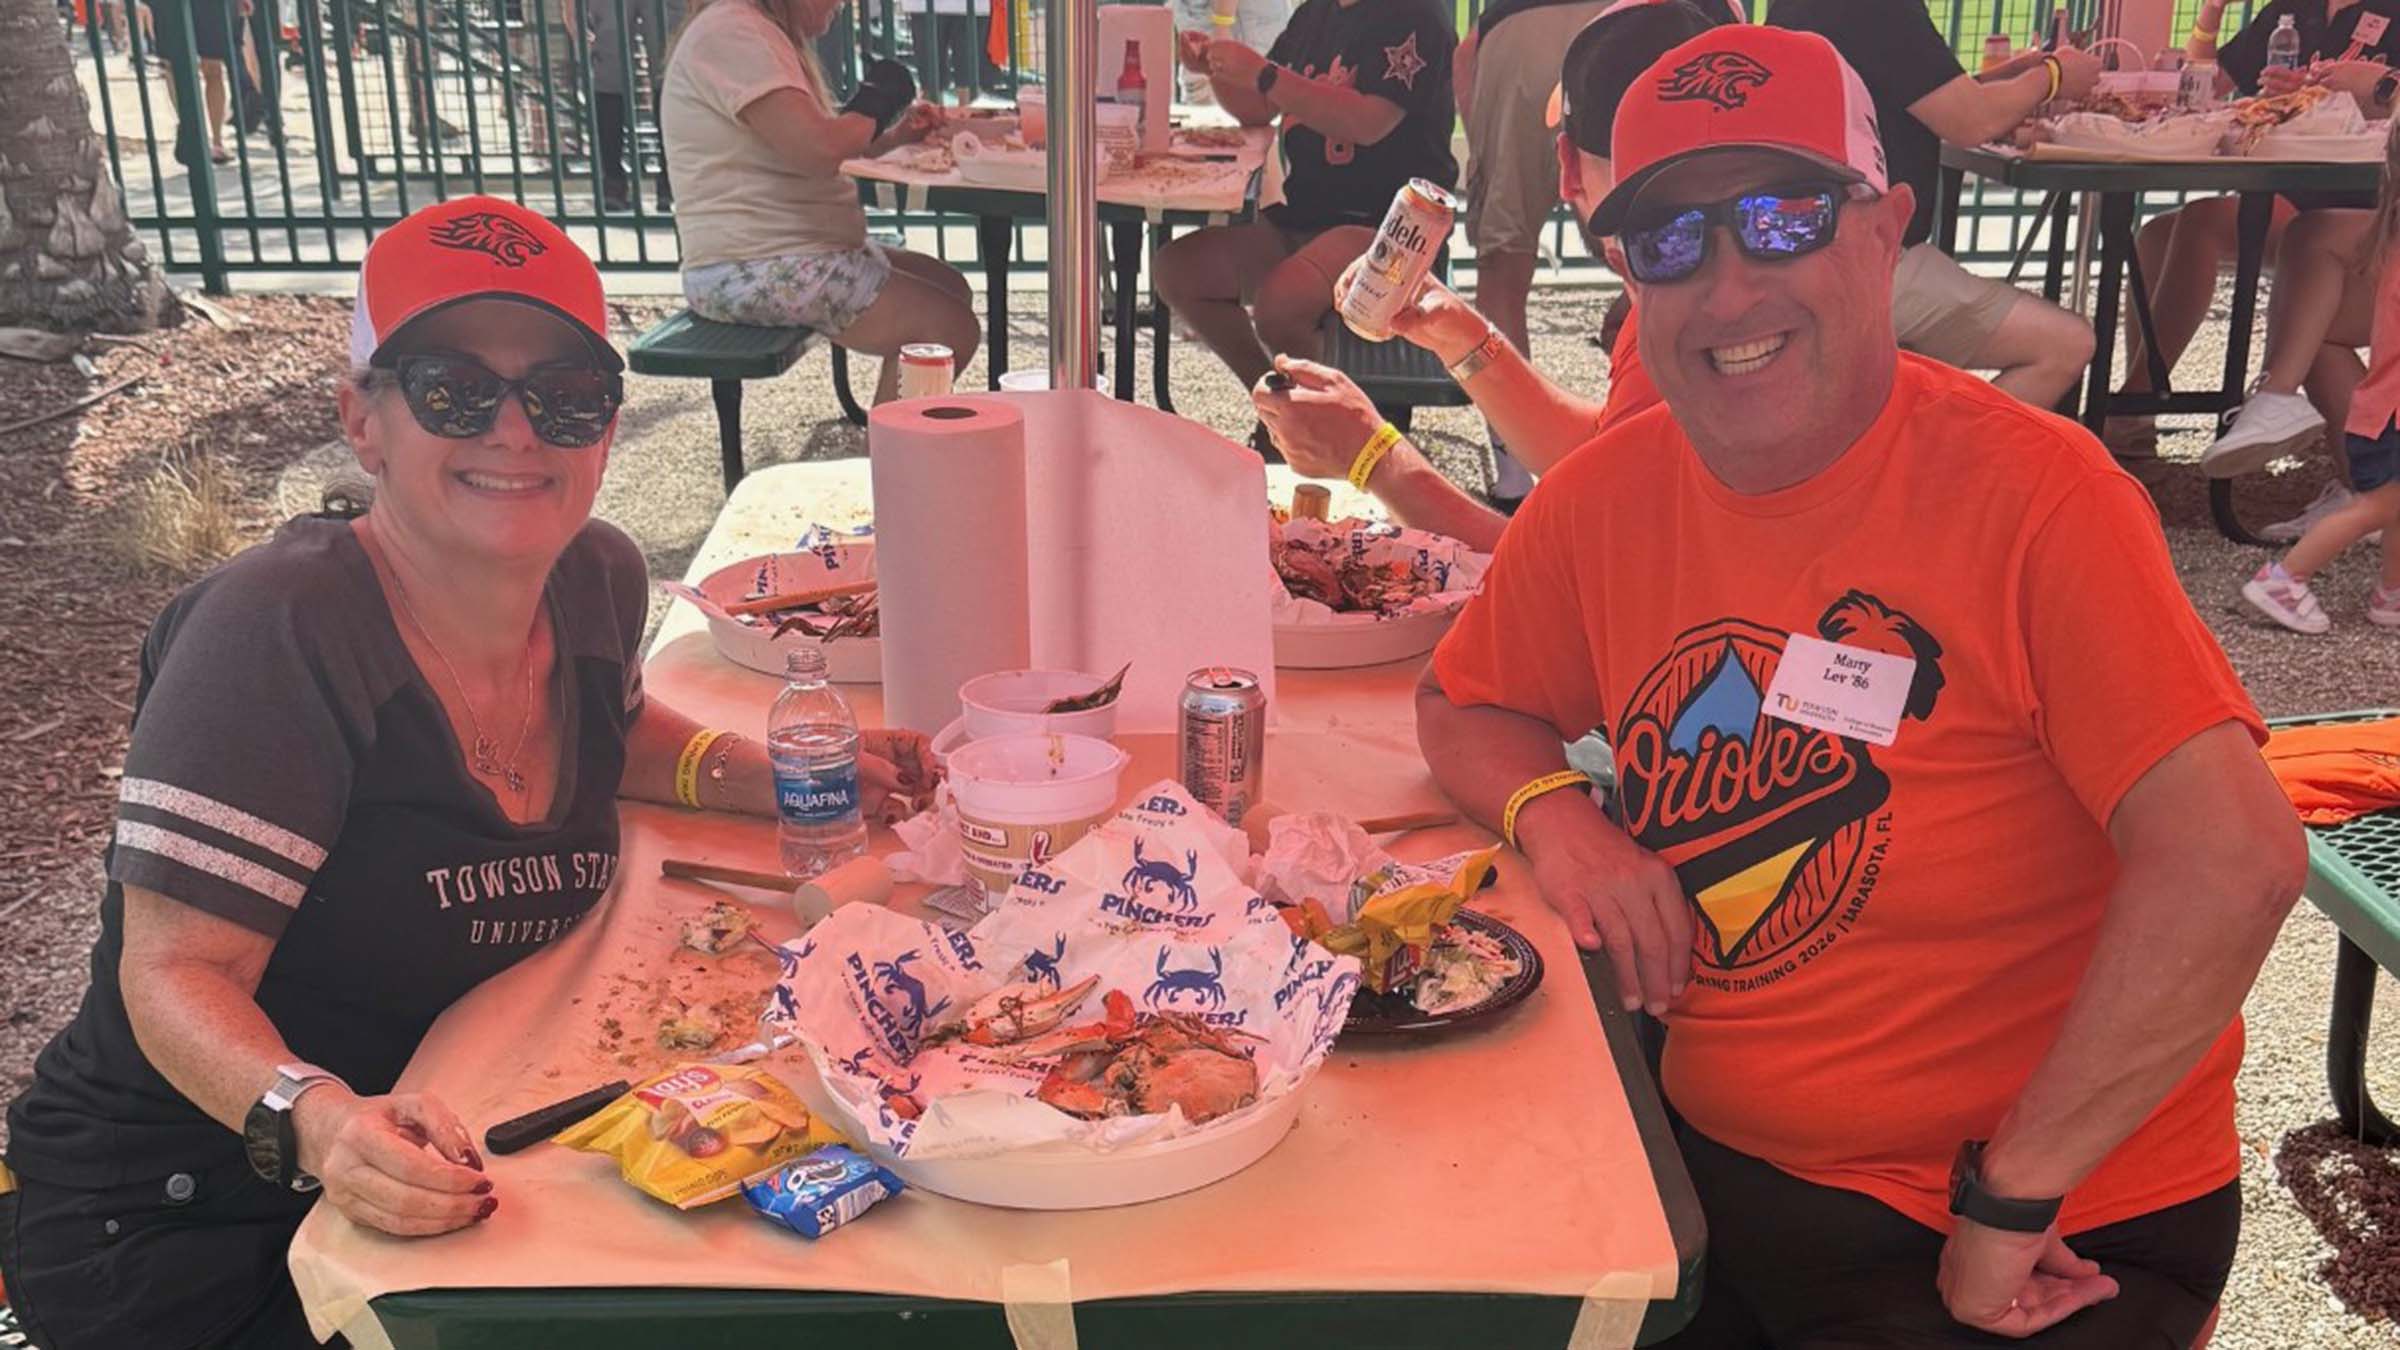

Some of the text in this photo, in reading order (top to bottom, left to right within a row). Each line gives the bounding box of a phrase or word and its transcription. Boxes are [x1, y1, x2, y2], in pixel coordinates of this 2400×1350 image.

[1823, 668, 1848, 685] Lev
[1776, 693, 1799, 712] TU
[783, 790, 849, 811] AQUAFINA
[426, 854, 563, 910] TOWSON
[1013, 870, 1066, 895] ERS
[1100, 893, 1216, 928] PINCHERS
[1691, 973, 1730, 992] RING
[1733, 962, 1797, 992] TRAINING
[1798, 931, 1837, 964] 2026
[1876, 811, 1894, 832] FL
